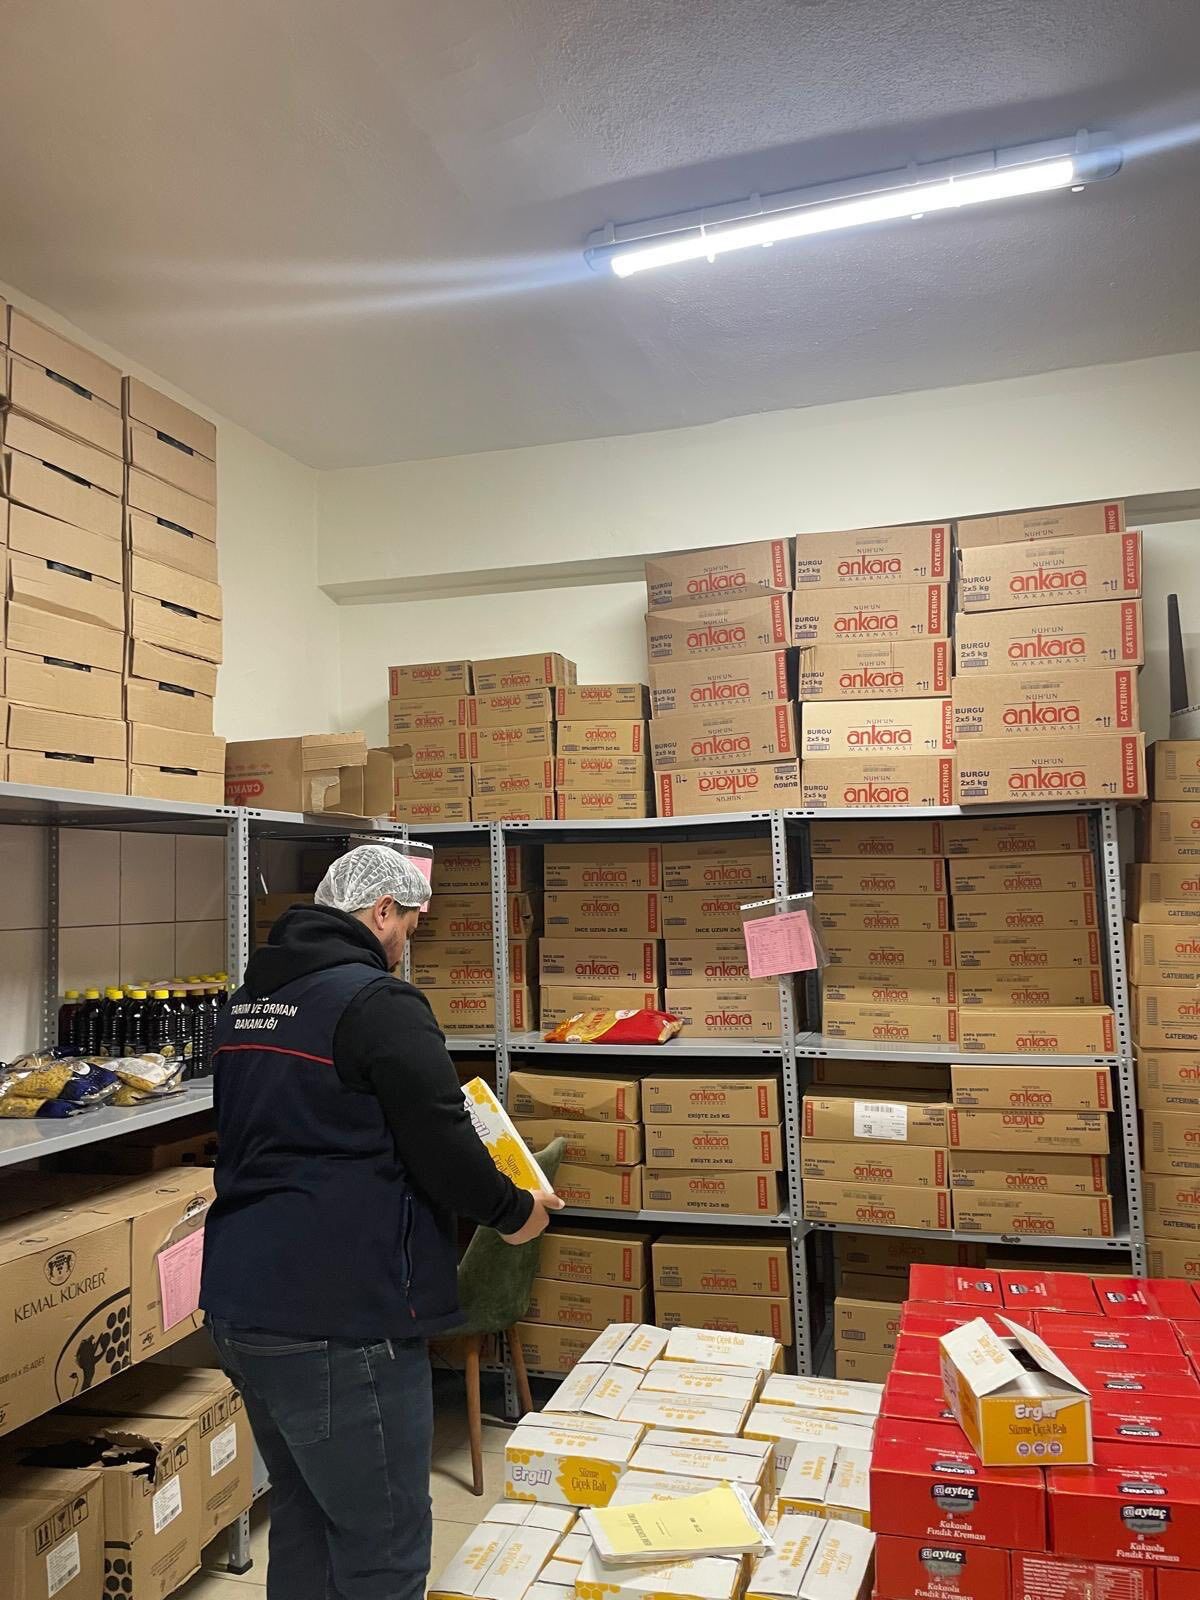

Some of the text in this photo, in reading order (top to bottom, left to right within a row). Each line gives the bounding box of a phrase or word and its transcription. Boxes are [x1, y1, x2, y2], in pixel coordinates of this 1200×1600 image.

[775, 545, 783, 583] CATERING
[837, 555, 901, 576] ankara
[1032, 559, 1065, 568] NUH'UN
[687, 572, 746, 593] ankara
[962, 576, 992, 584] BURGU
[1009, 567, 1087, 593] ankara
[774, 599, 782, 638] CATERING
[834, 611, 898, 632] ankara
[1031, 626, 1064, 634] NUH'UN
[1126, 608, 1134, 654] CATERING
[687, 626, 746, 648] ankara
[1007, 634, 1086, 660] ankara
[778, 656, 786, 694] CATERING
[840, 668, 904, 688] ankara
[690, 682, 749, 702] ankara
[1002, 702, 1080, 725] ankara
[585, 728, 616, 739] ankara
[778, 711, 788, 748] CATERING
[847, 725, 912, 745] ankara
[691, 736, 751, 756] ankara
[1008, 766, 1087, 789] ankara
[699, 774, 759, 795] ankara
[663, 779, 672, 817] CATERING
[844, 783, 909, 803] ankara
[443, 856, 480, 867] ankara
[582, 868, 627, 881] ankara
[704, 866, 751, 881] ankara
[1004, 875, 1042, 888] ankara
[581, 900, 619, 912] ankara
[864, 914, 899, 926] ankara
[1006, 912, 1044, 926] ankara
[868, 950, 904, 963] ankara
[1009, 950, 1048, 964] ankara
[576, 960, 619, 975] ankara
[872, 988, 908, 999] ankara
[1011, 988, 1050, 1001] ankara
[231, 1003, 298, 1017] TARIM VE ORMAN
[450, 999, 486, 1010] ankara
[235, 1017, 278, 1030] BAKANLIĞI
[705, 1010, 752, 1025] ankara
[873, 1024, 908, 1037] ankara
[1016, 1034, 1058, 1047] ankara
[689, 1089, 726, 1101] ankara
[1010, 1091, 1052, 1103] ankara
[1003, 1114, 1044, 1127] ankara
[692, 1134, 729, 1146] ankara
[854, 1164, 893, 1177] ankara
[688, 1179, 725, 1190] ankara
[1006, 1172, 1047, 1185] ankara
[856, 1205, 895, 1219] ankara
[1012, 1216, 1054, 1229] ankara
[1163, 1220, 1195, 1229] CATERING
[559, 1263, 592, 1274] ankara
[701, 1274, 736, 1288] ankara
[14, 1271, 107, 1324] KEMAL KÜKRER
[1009, 1424, 1031, 1435] Süzme
[512, 1466, 551, 1486] Ergül
[579, 1467, 599, 1478] Süzme
[571, 1478, 607, 1492] Çiçek Balı
[940, 1520, 972, 1531] Kakaolu
[927, 1527, 986, 1541] Fındık Kreması
[1130, 1542, 1165, 1552] Kakaolu
[1117, 1550, 1180, 1562] Fındık Kreması
[915, 1589, 939, 1599] Fındık
[928, 1583, 960, 1593] Kakaolu
